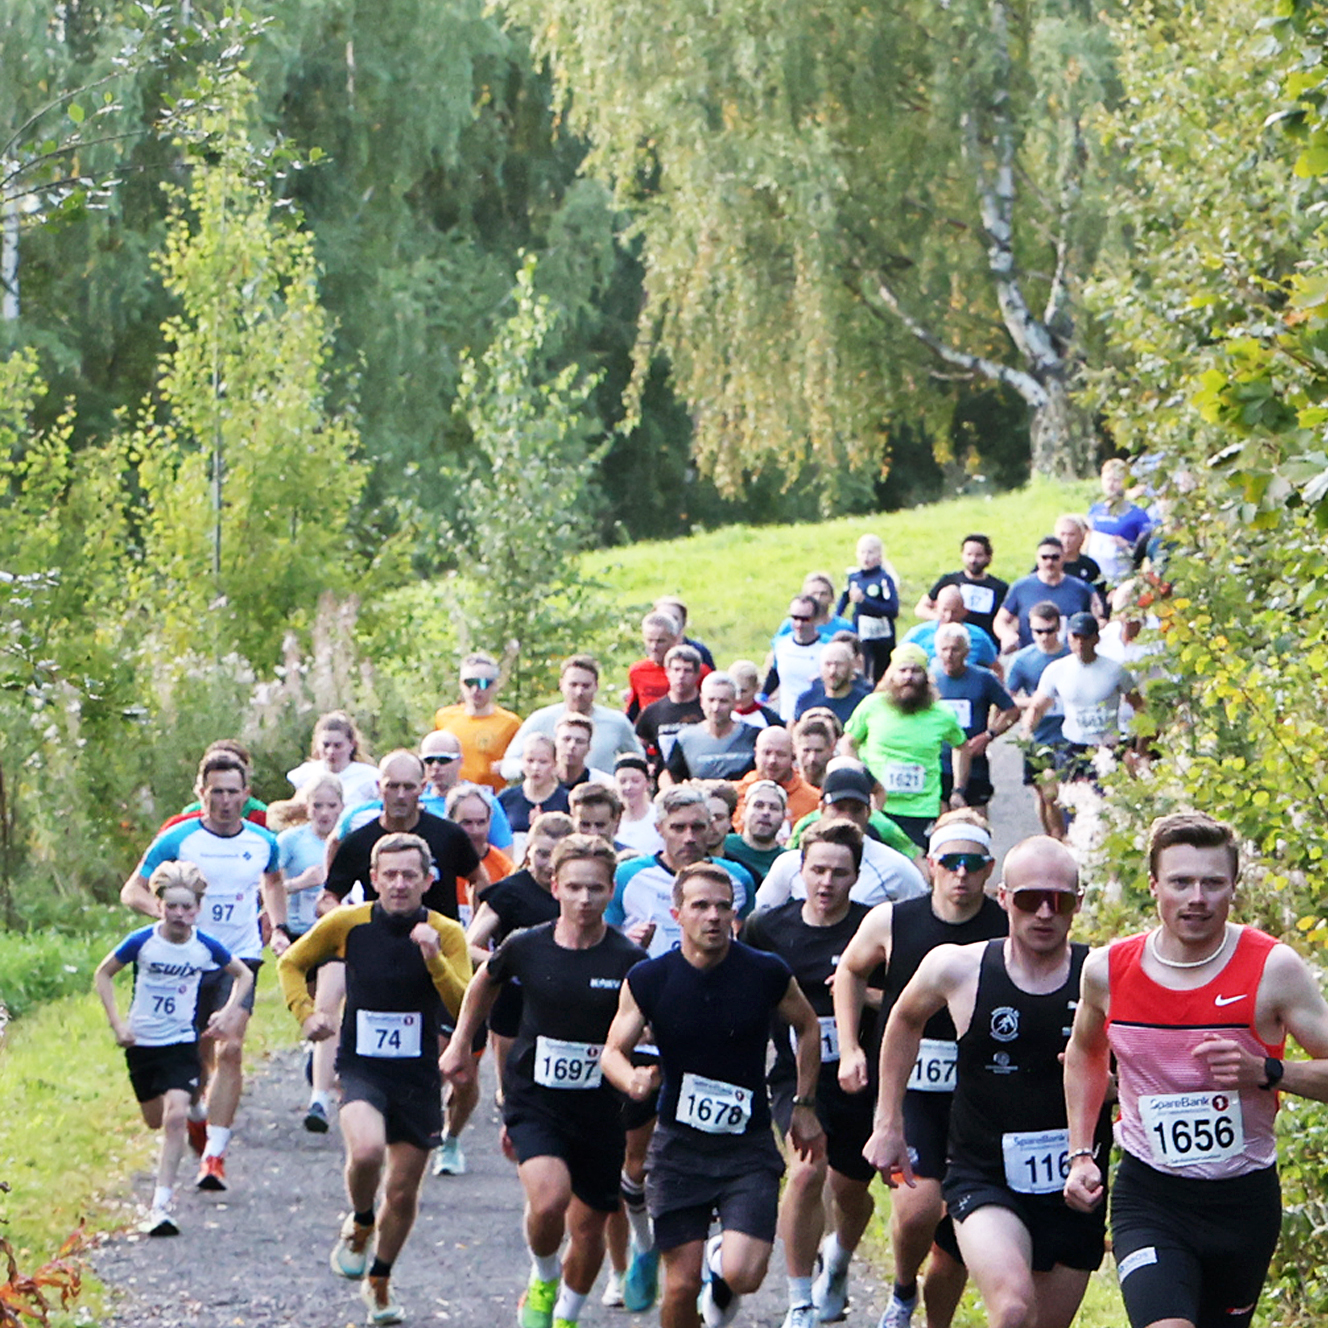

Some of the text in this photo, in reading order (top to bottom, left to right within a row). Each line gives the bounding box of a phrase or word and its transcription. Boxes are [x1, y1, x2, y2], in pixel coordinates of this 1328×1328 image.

[212, 904, 234, 921] 97
[152, 995, 175, 1014] 76
[375, 1029, 401, 1049] 74
[544, 1056, 598, 1081] 1697
[688, 1094, 743, 1125] 1678
[1151, 1096, 1210, 1110] SpareBank
[1153, 1116, 1234, 1154] 1656
